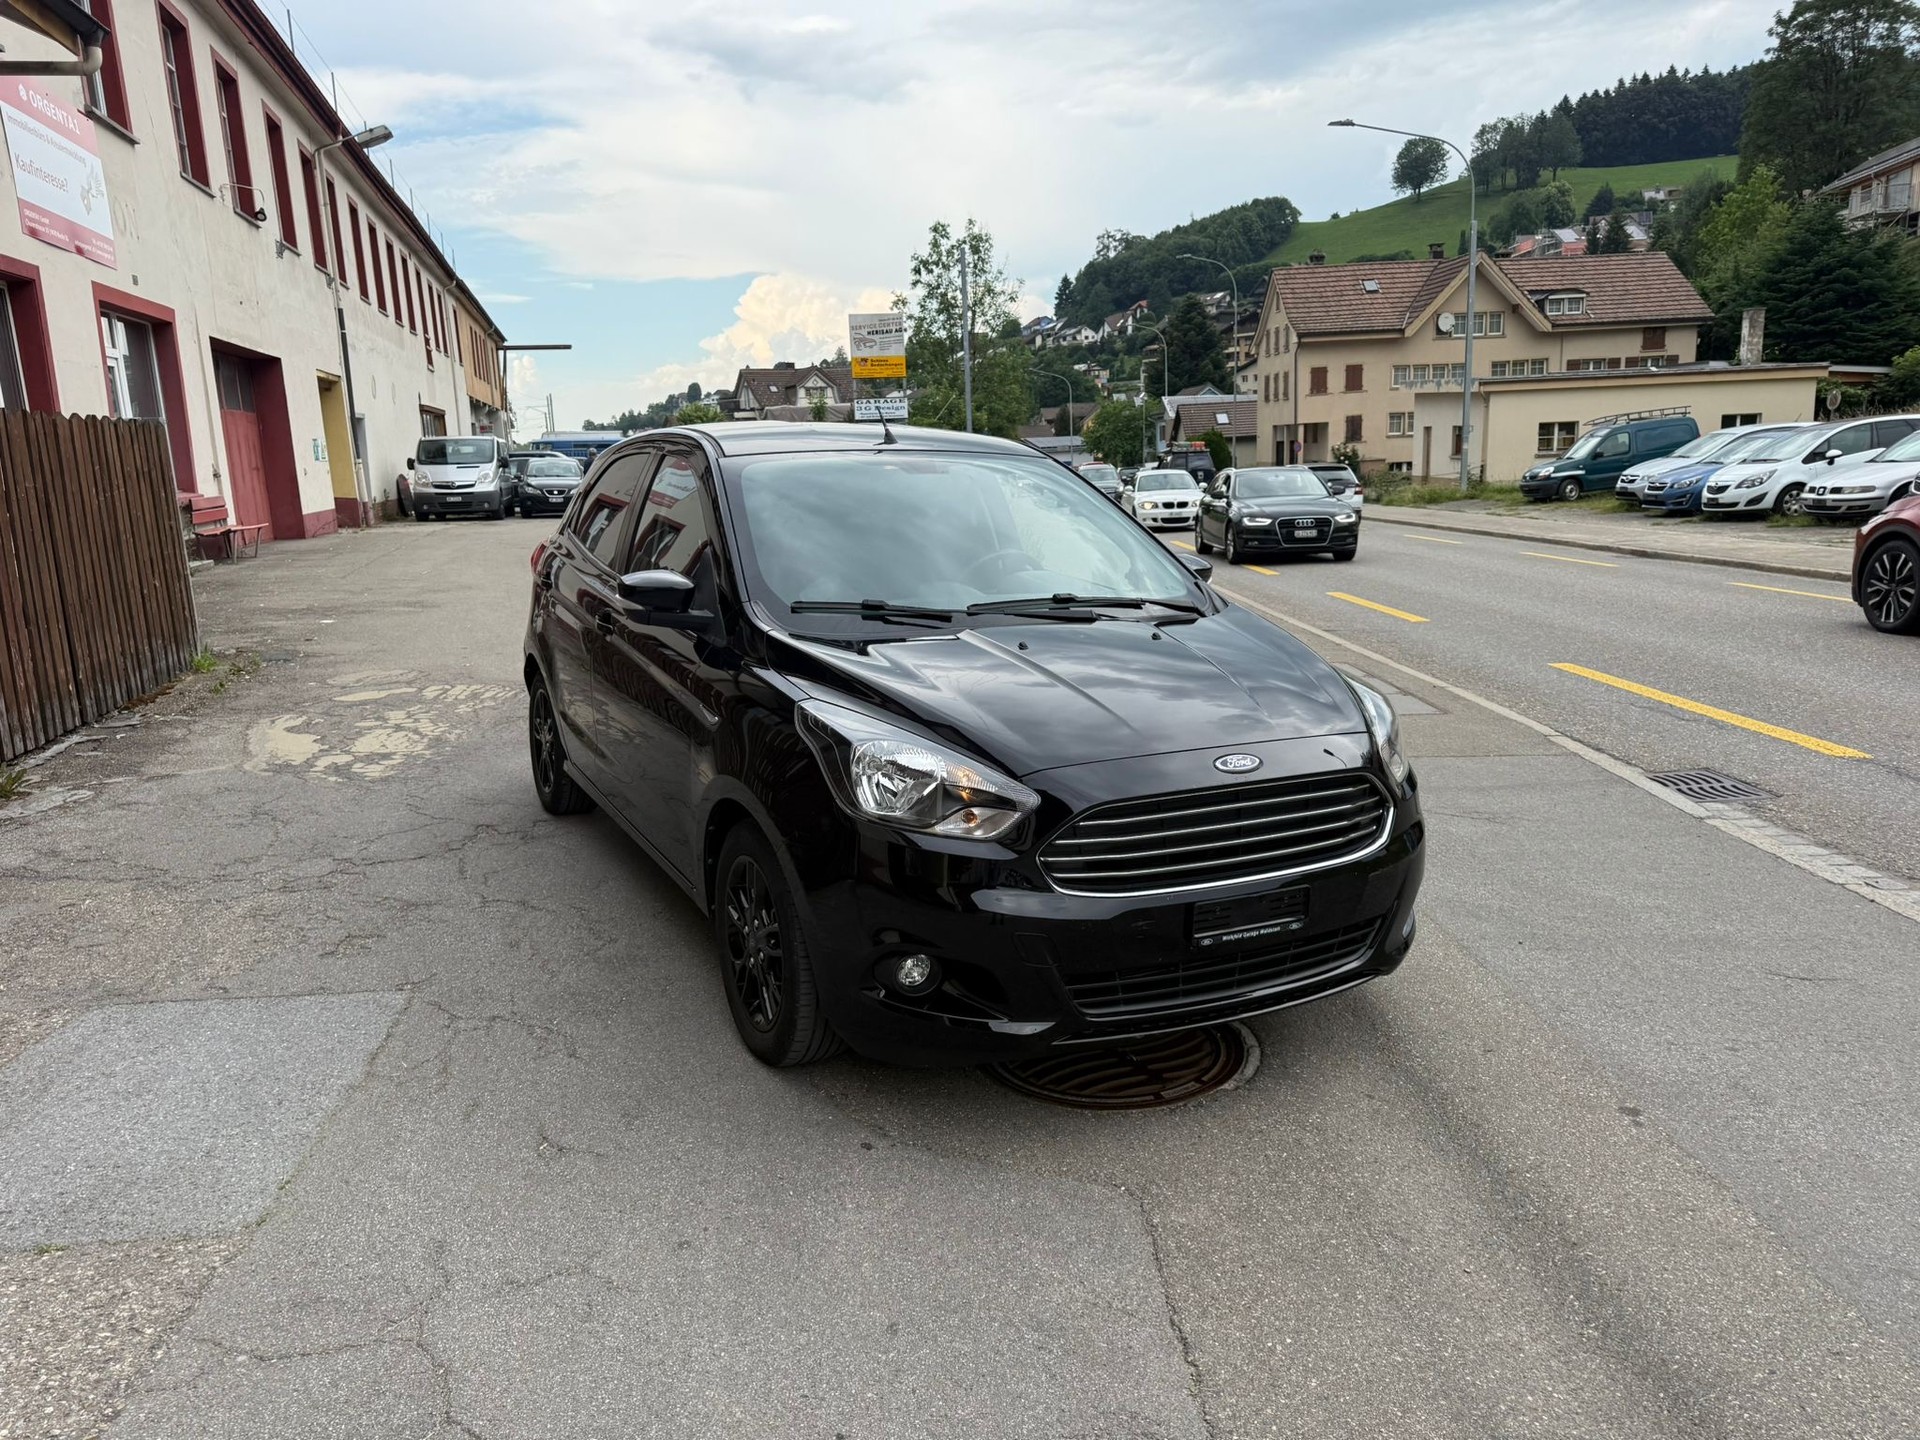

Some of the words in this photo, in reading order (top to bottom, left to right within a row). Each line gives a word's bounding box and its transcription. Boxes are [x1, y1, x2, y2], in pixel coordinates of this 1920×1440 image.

[14, 152, 69, 193] Kaufinteresse?
[851, 323, 877, 331] SERVICE
[878, 321, 902, 329] CENTER
[867, 328, 893, 336] HERISAU
[1226, 755, 1252, 768] Ford
